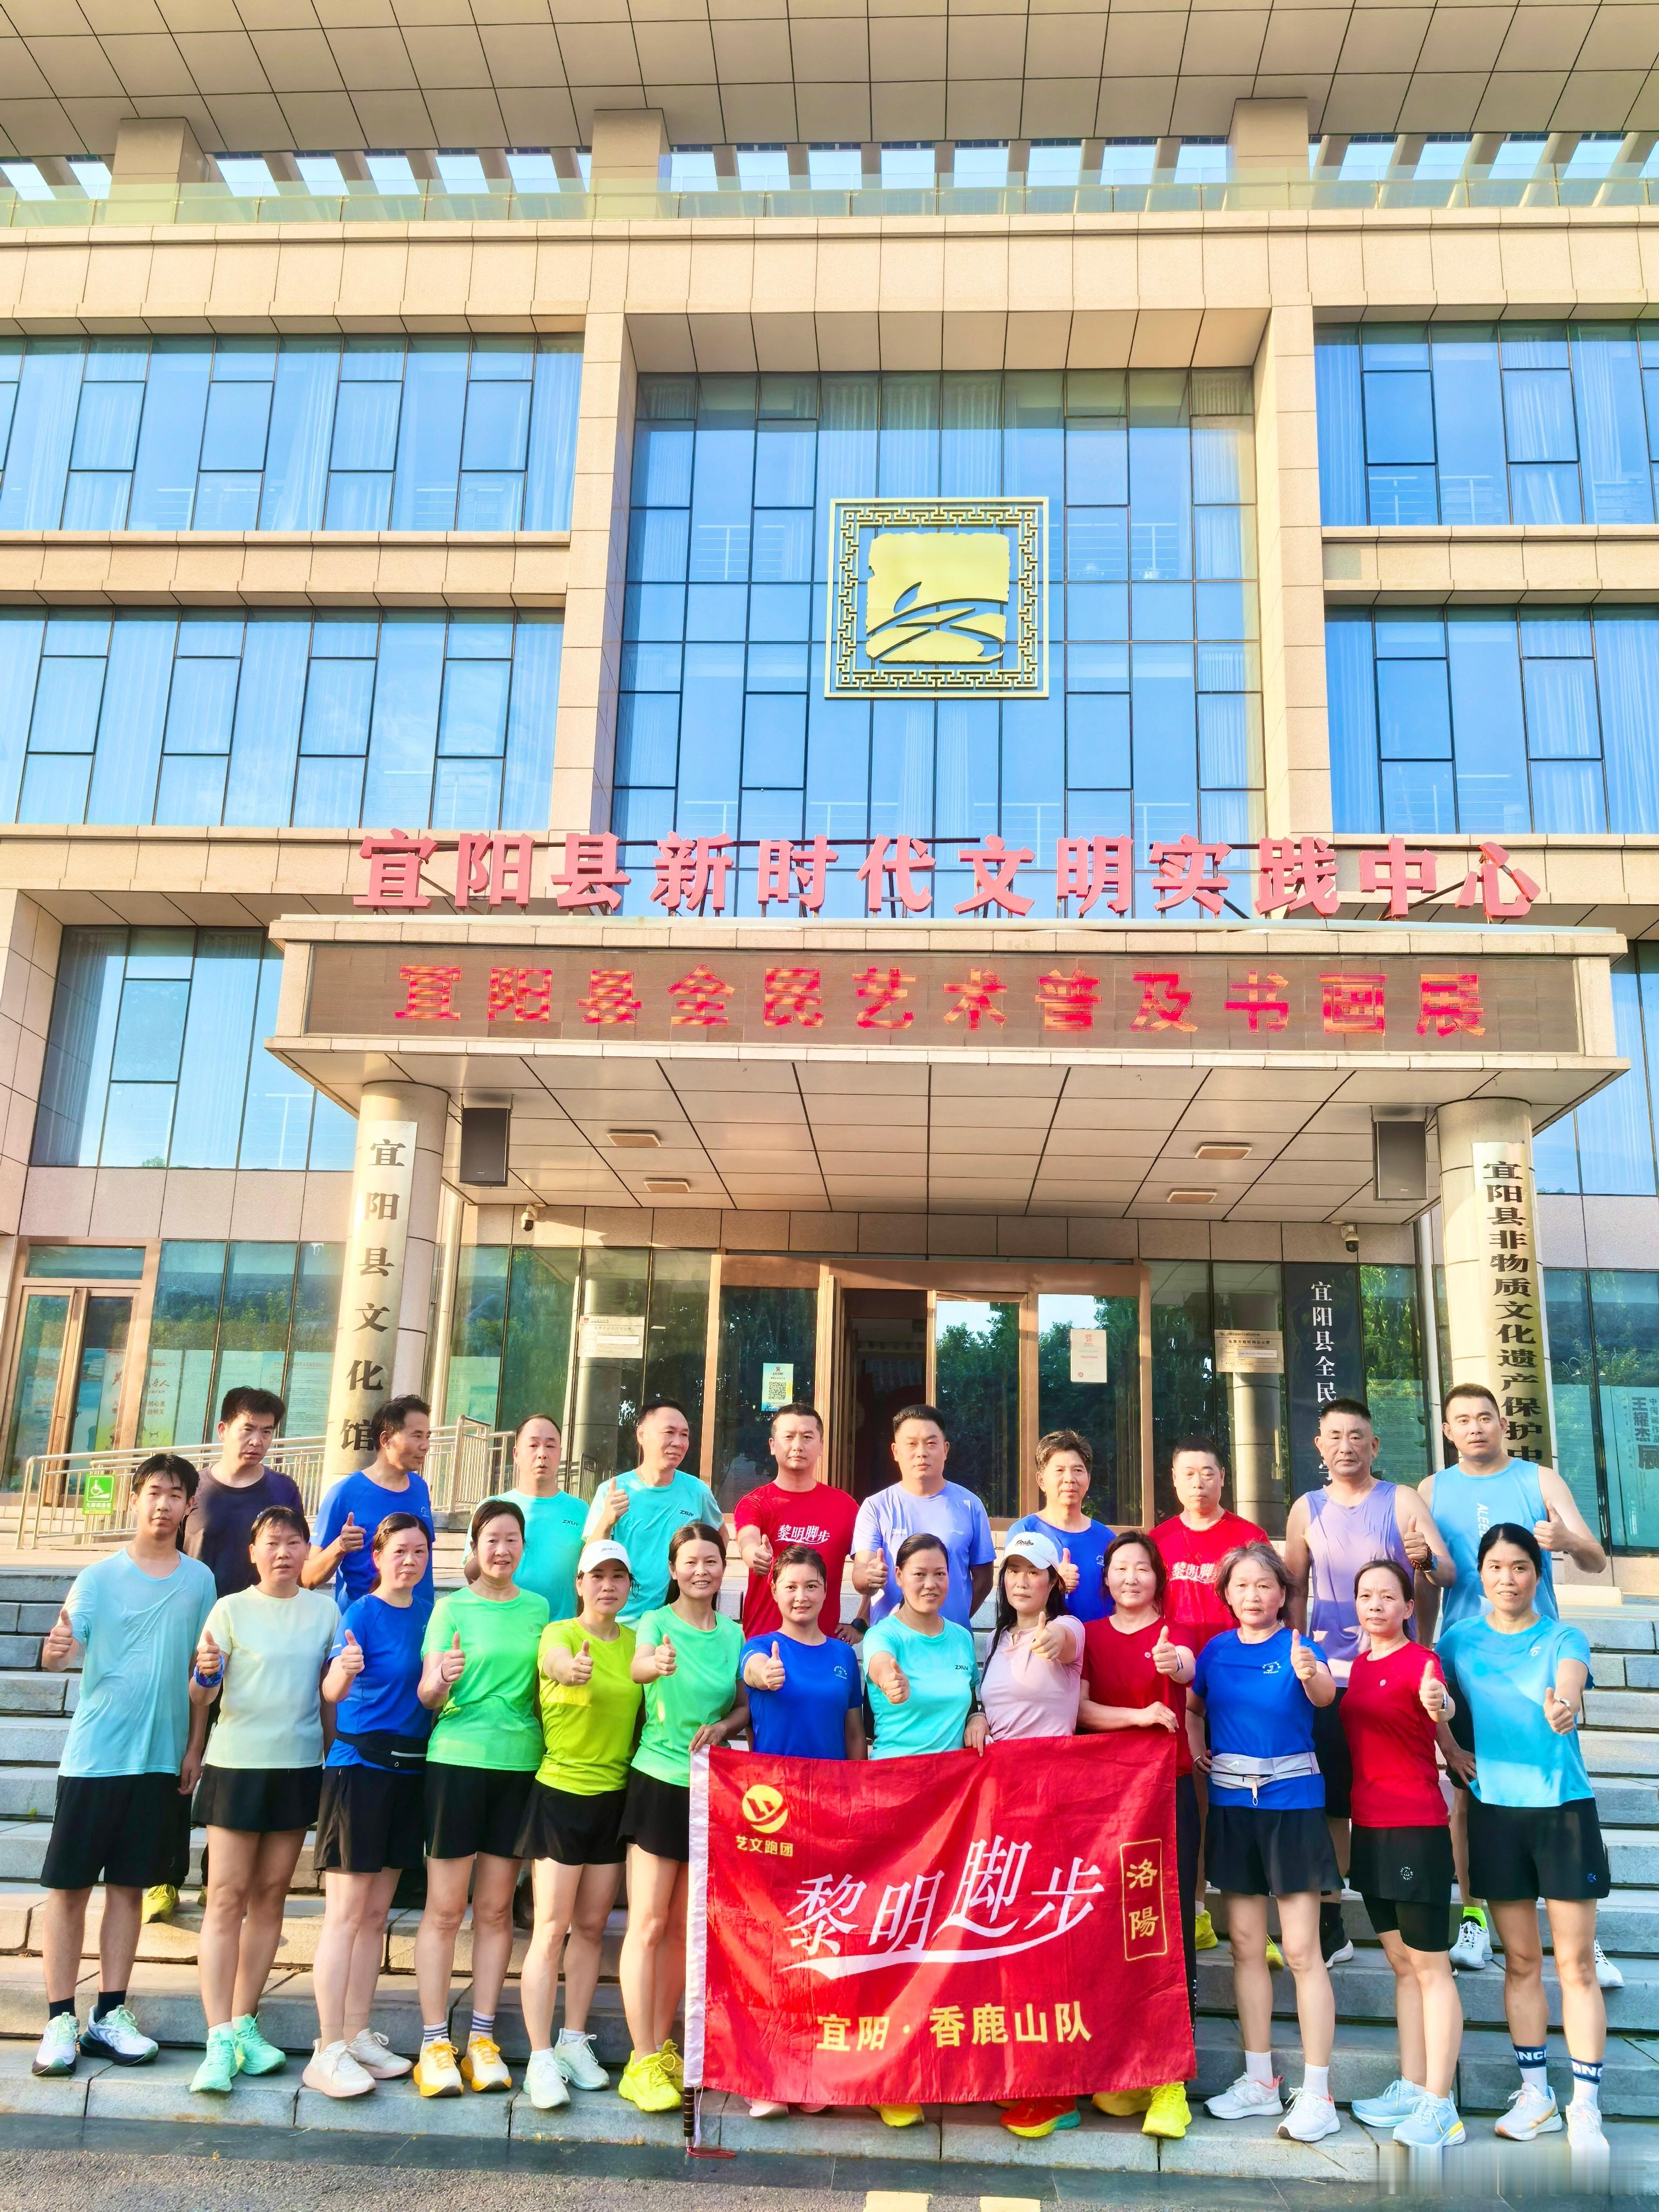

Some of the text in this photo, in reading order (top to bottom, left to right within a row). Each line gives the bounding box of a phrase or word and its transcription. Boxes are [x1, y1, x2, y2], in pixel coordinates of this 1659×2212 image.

[353, 828, 1540, 919] 宜阳县新时代文明实践中心
[395, 965, 1485, 1037] 宜阳县全民艺术普及书画展
[341, 1139, 405, 1451] 宜阳县文化馆
[1483, 1161, 1543, 1464] 宜阳县非物质文化遗产保护中
[1311, 1281, 1337, 1481] 宜阳县全民
[775, 1524, 830, 1544] 黎明脚步
[735, 1835, 793, 1857] 艺文跑团
[781, 1835, 1105, 1979] 黎明脚步
[1126, 1858, 1159, 1940] 洛陽
